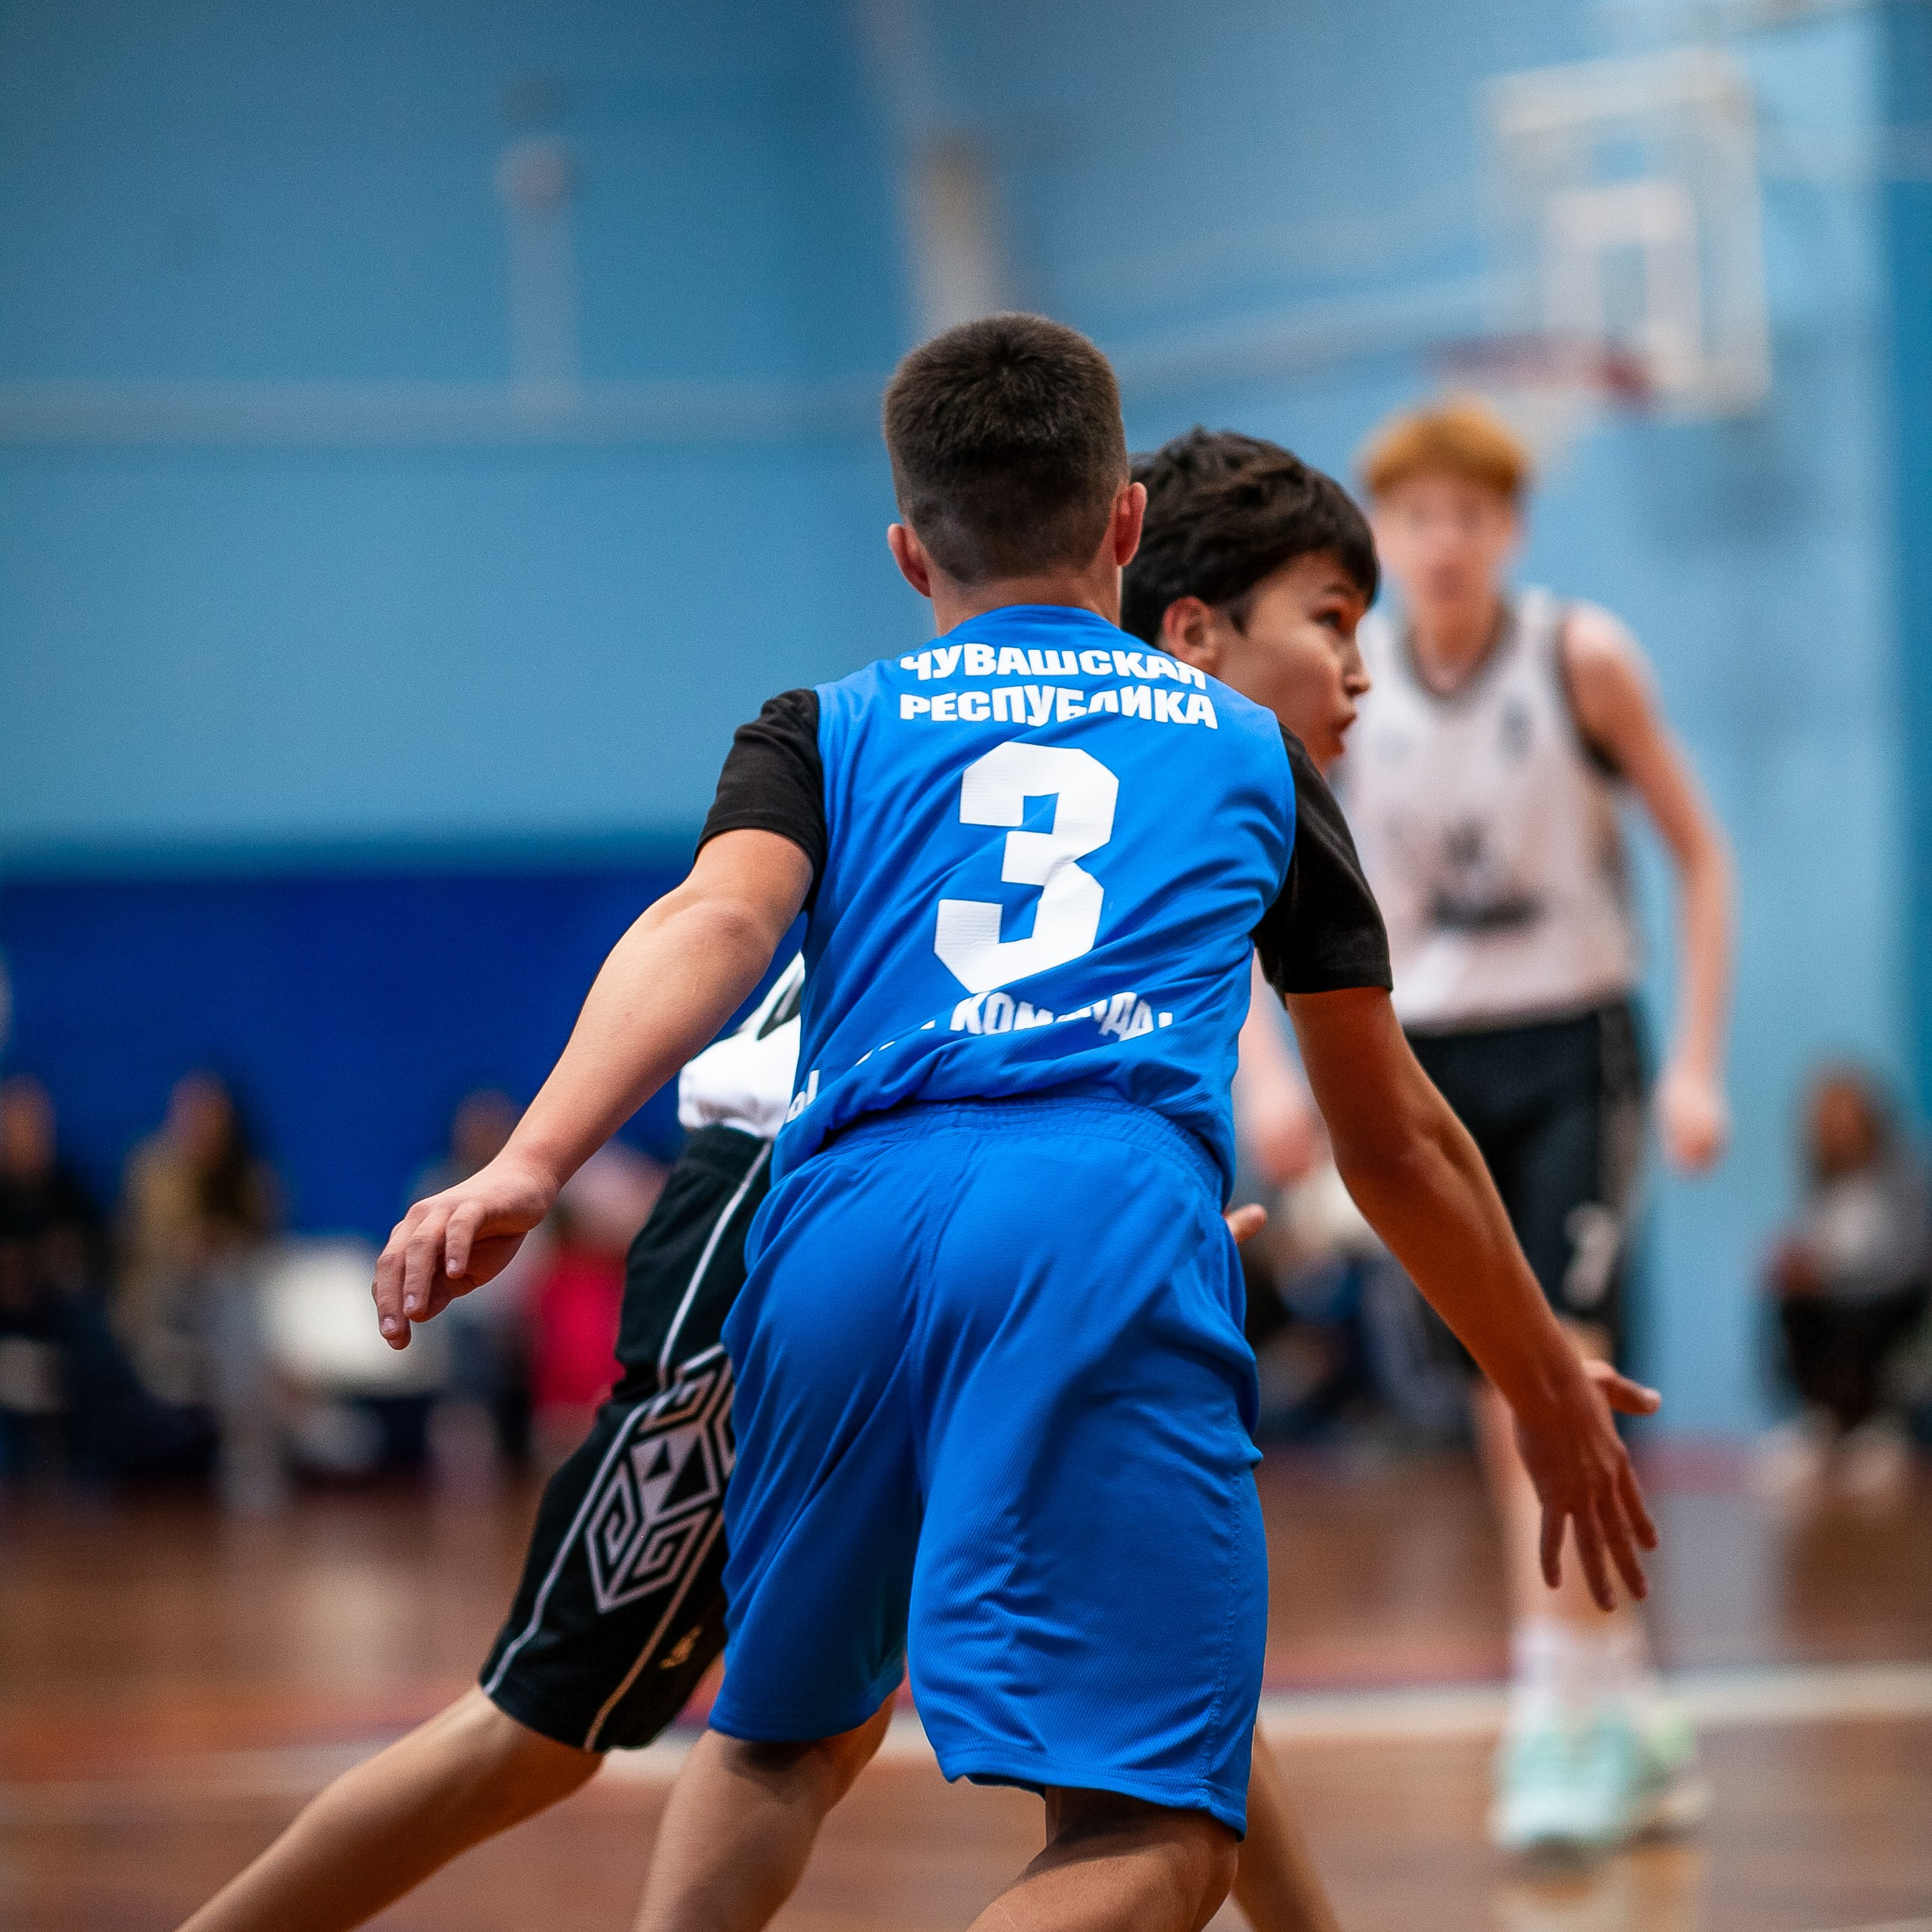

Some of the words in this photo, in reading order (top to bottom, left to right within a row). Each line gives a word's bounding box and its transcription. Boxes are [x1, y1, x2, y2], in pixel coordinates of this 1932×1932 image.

[900, 643, 1206, 690] ЧУВАШСКАЯ
[900, 685, 1218, 730] РЕСПУБЛИКА
[934, 741, 1119, 994] 3
